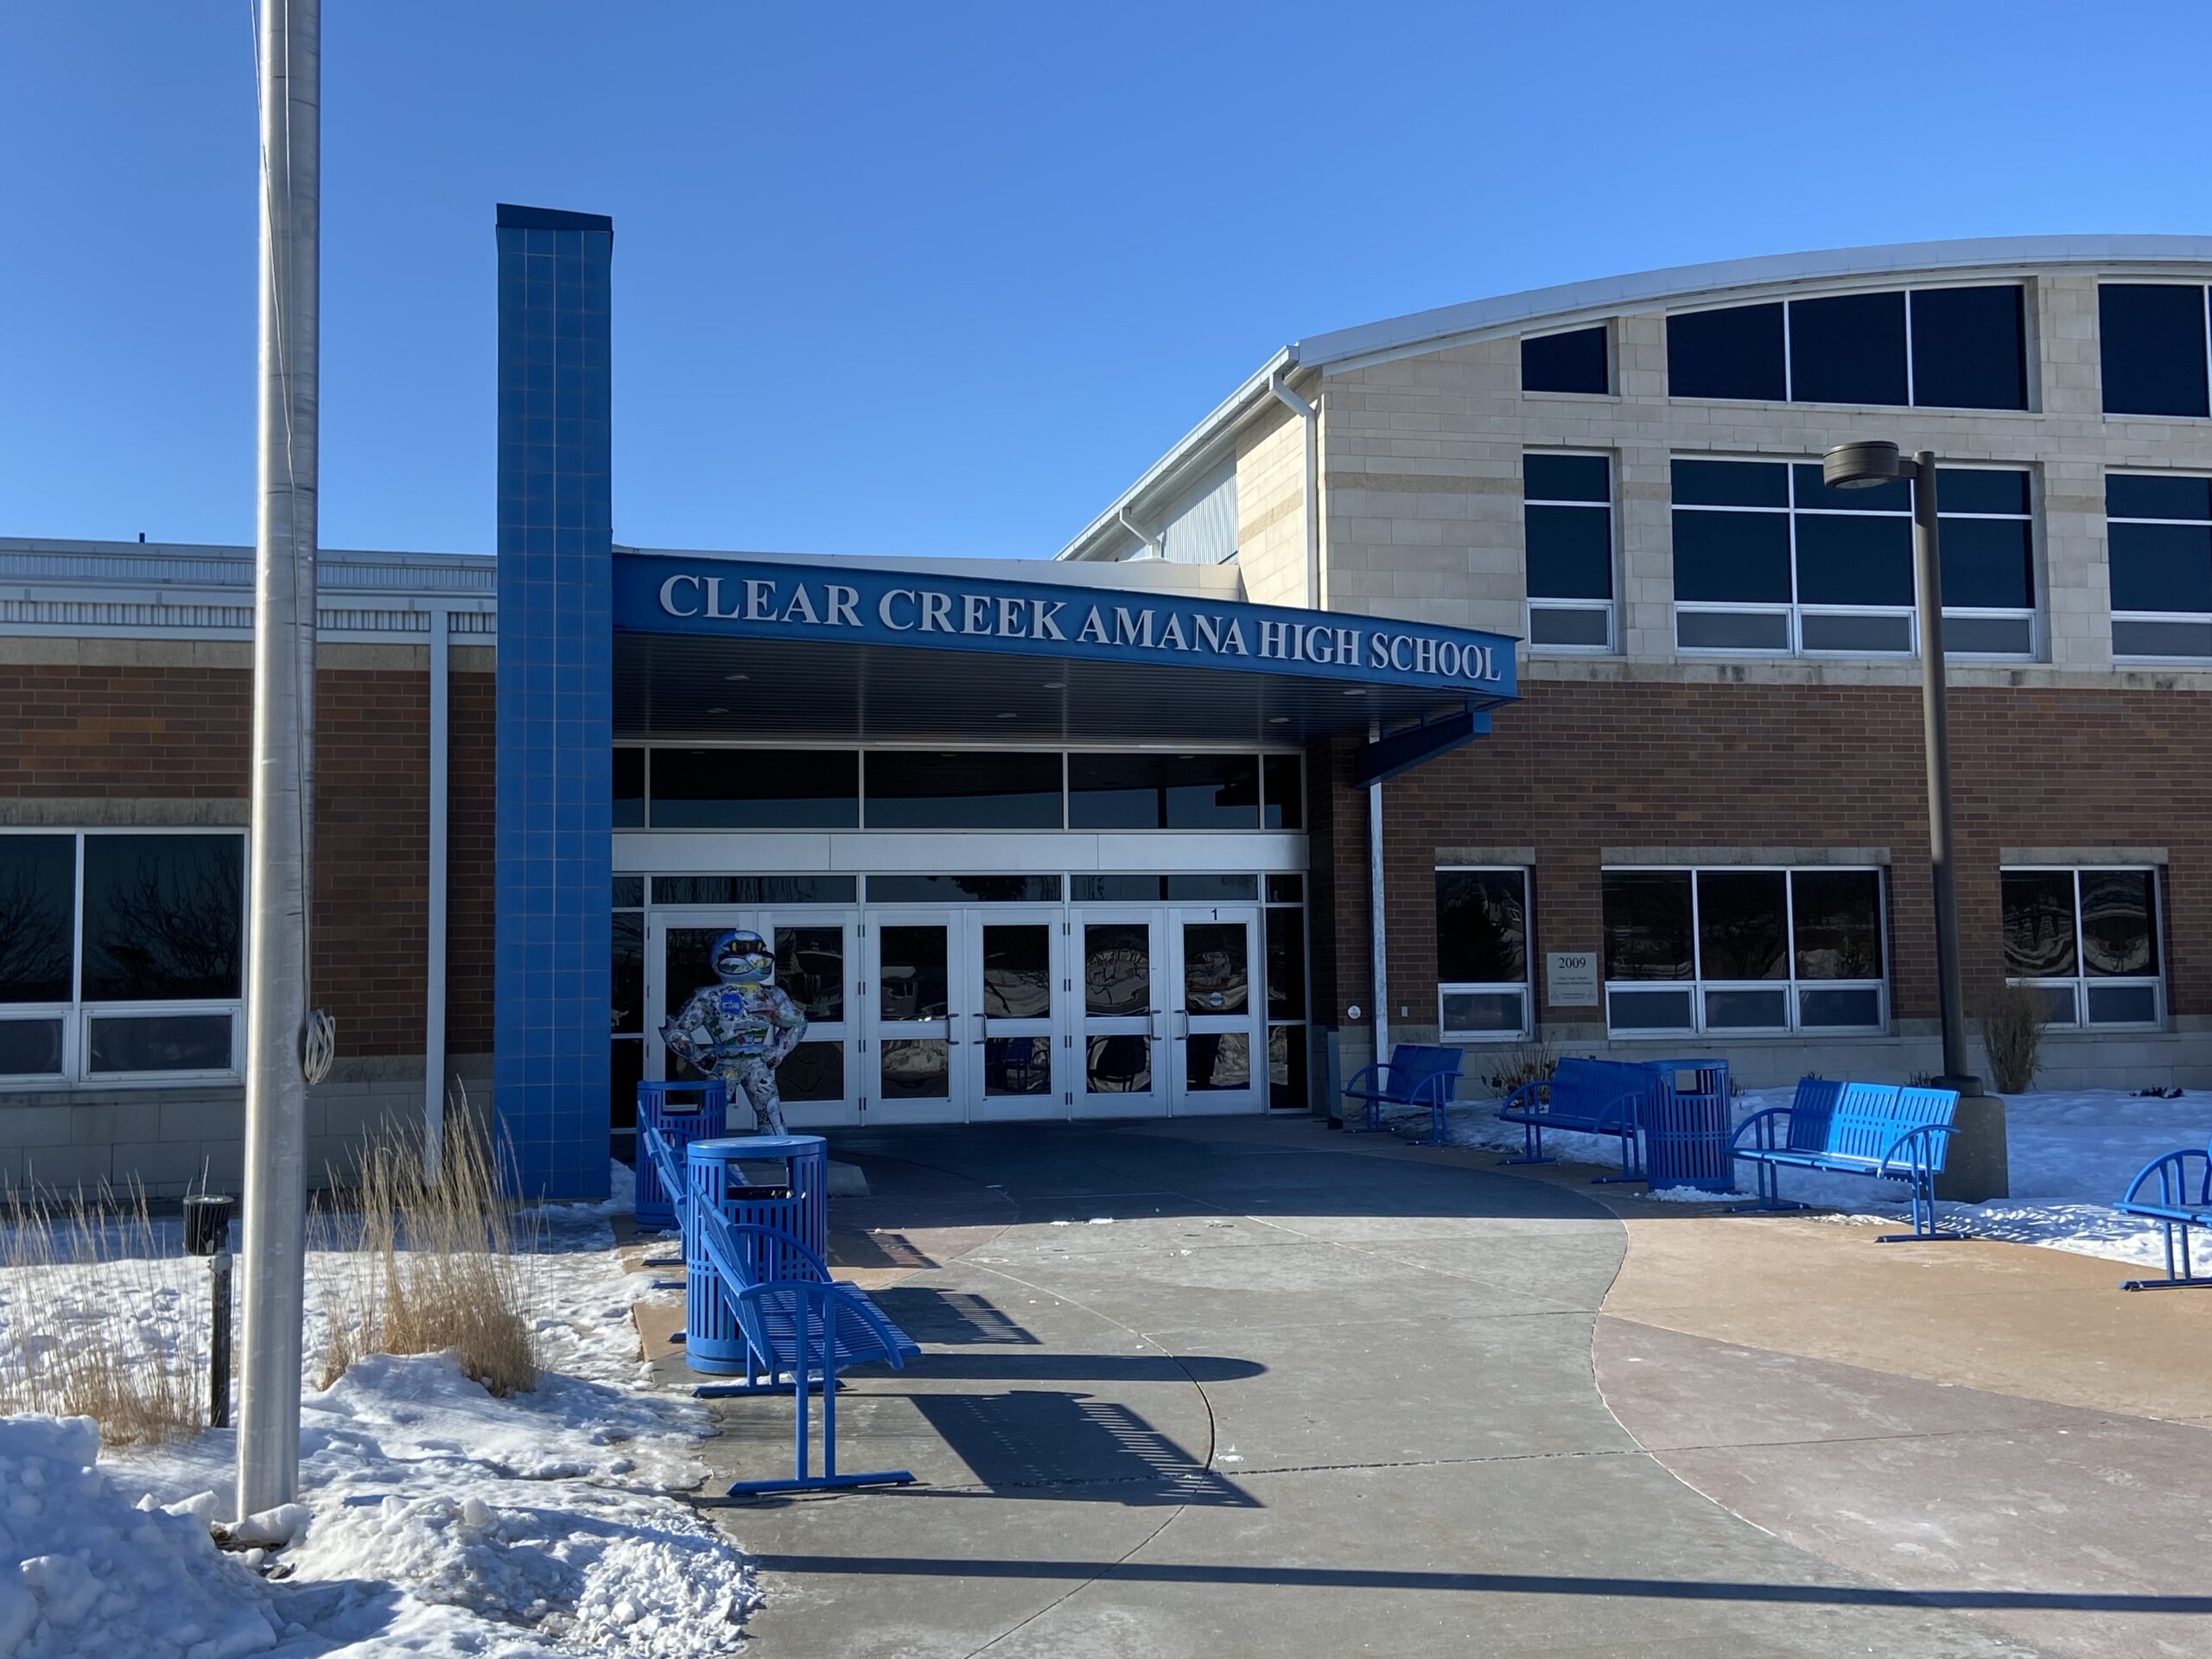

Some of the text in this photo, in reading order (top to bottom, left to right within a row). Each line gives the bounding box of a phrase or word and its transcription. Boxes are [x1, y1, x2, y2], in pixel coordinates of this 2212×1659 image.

[659, 574, 1502, 682] CLEAR CREEK AMANA HIGH SCHOOL
[1211, 907, 1217, 921] 1
[1558, 957, 1586, 969] 2009
